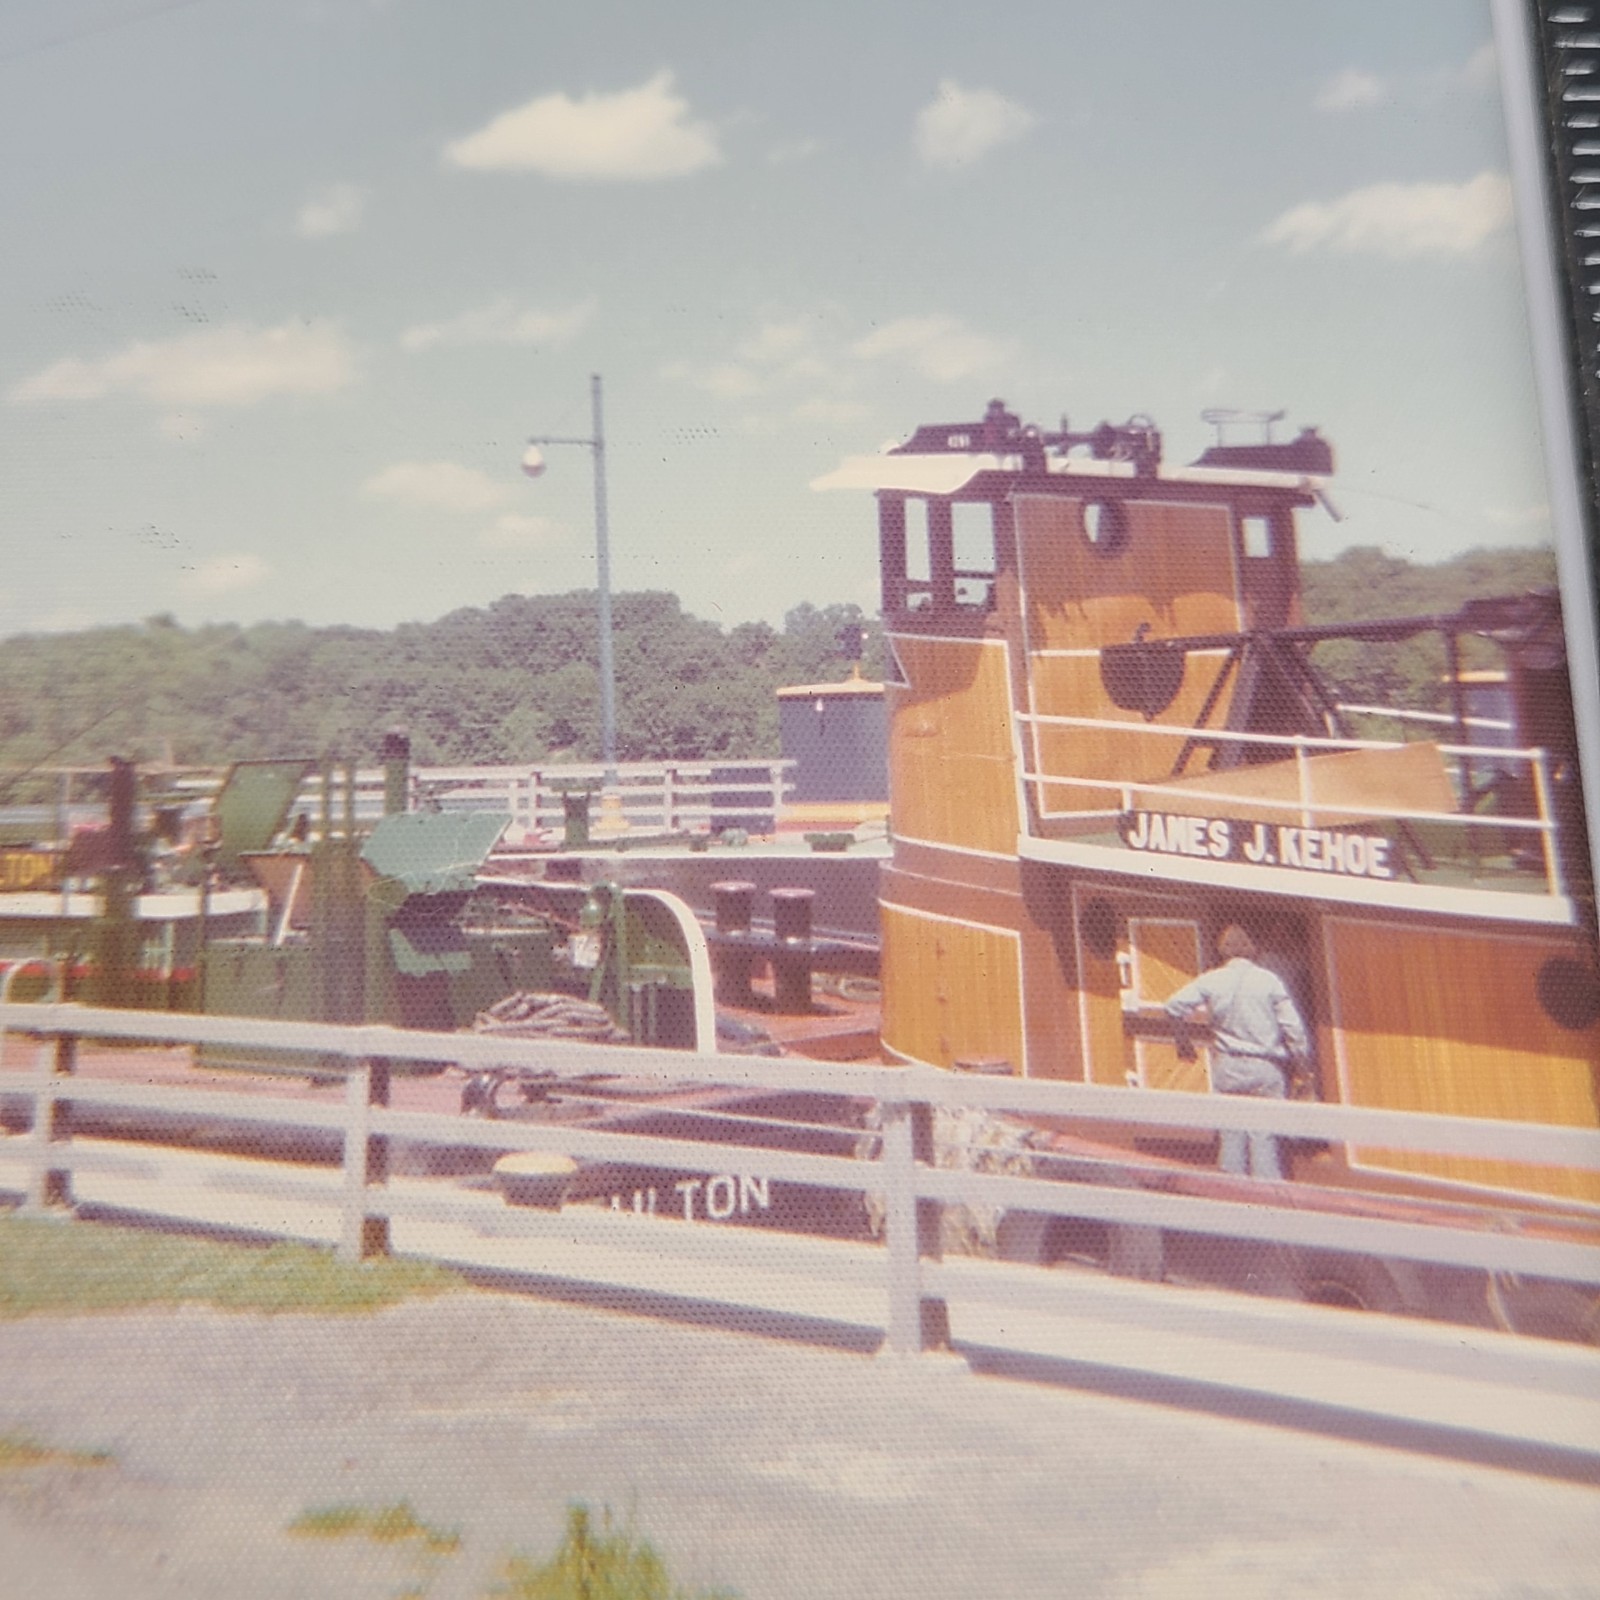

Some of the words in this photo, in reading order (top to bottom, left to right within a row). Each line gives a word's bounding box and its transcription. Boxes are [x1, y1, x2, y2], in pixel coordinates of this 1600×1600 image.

[1128, 812, 1231, 858] JAMES
[1243, 823, 1275, 863] J.
[1279, 826, 1392, 878] KEHOE
